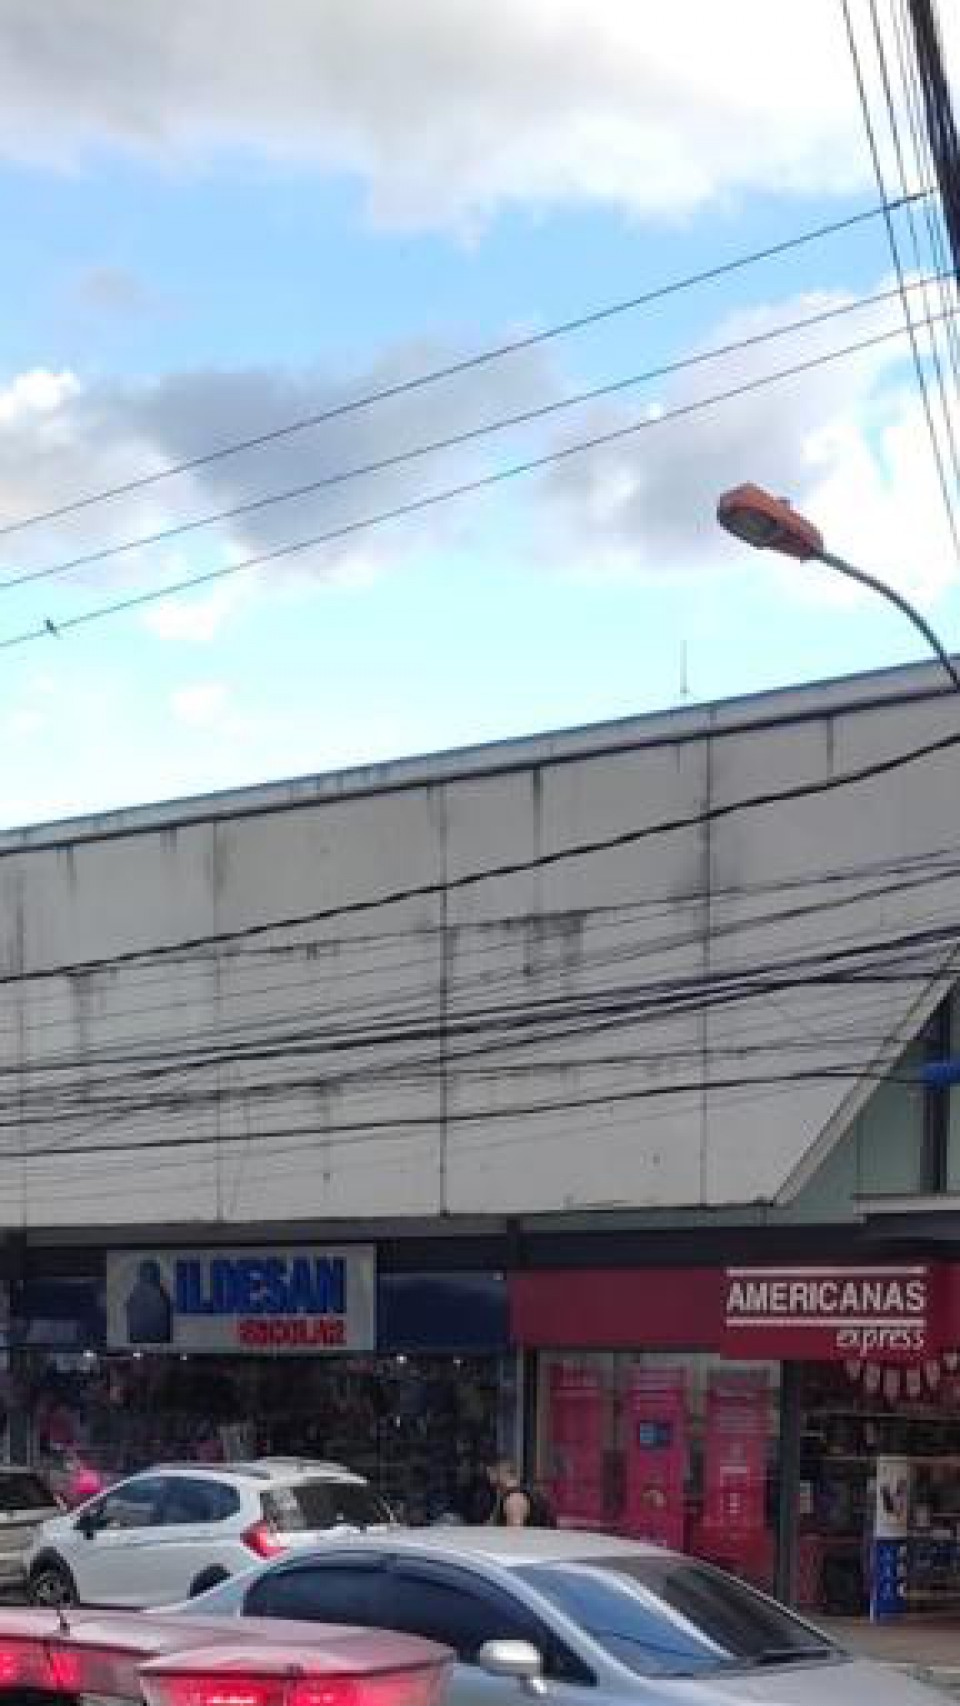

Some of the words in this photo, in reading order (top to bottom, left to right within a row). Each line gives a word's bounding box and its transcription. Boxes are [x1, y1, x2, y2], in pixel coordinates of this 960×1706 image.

[176, 1257, 346, 1314] ILDESAN
[726, 1281, 926, 1312] AMERICANAS
[836, 1328, 925, 1357] express
